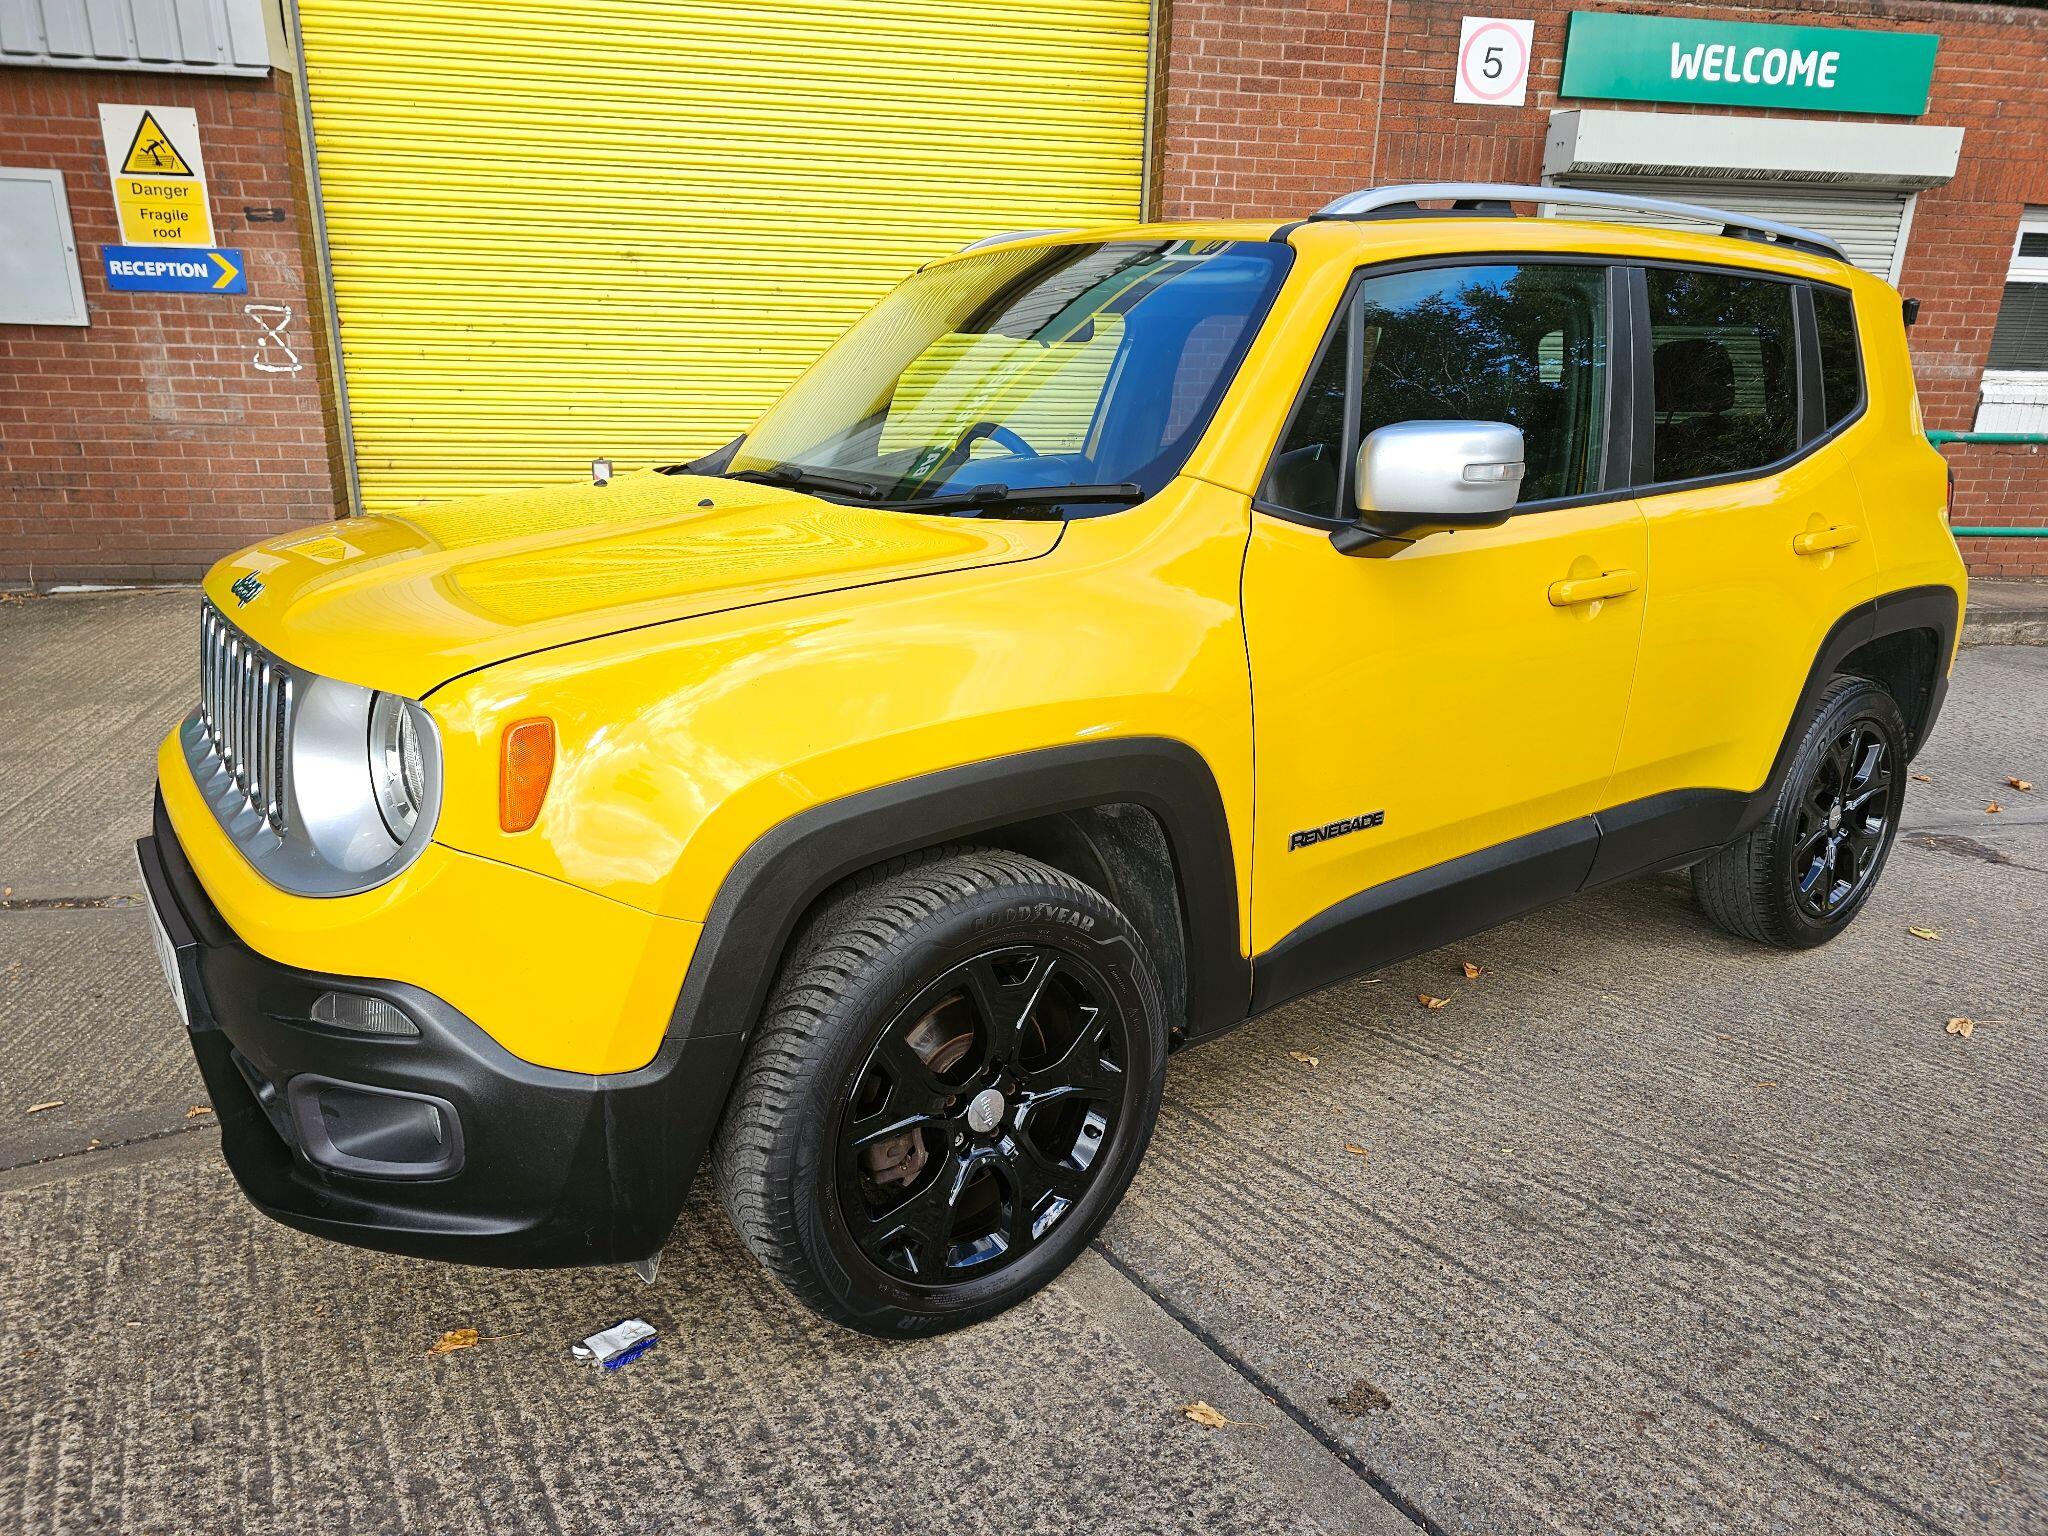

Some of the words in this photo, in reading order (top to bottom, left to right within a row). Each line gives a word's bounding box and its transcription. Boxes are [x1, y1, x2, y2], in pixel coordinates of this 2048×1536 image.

[1482, 46, 1505, 79] 5
[1670, 41, 1841, 88] WELCOME
[131, 182, 189, 200] Danger
[140, 208, 189, 223] Fragile
[153, 226, 181, 238] roof
[109, 260, 209, 278] RECEPTION
[1288, 809, 1385, 852] RENEGADE
[972, 903, 1096, 933] GOODYEAR
